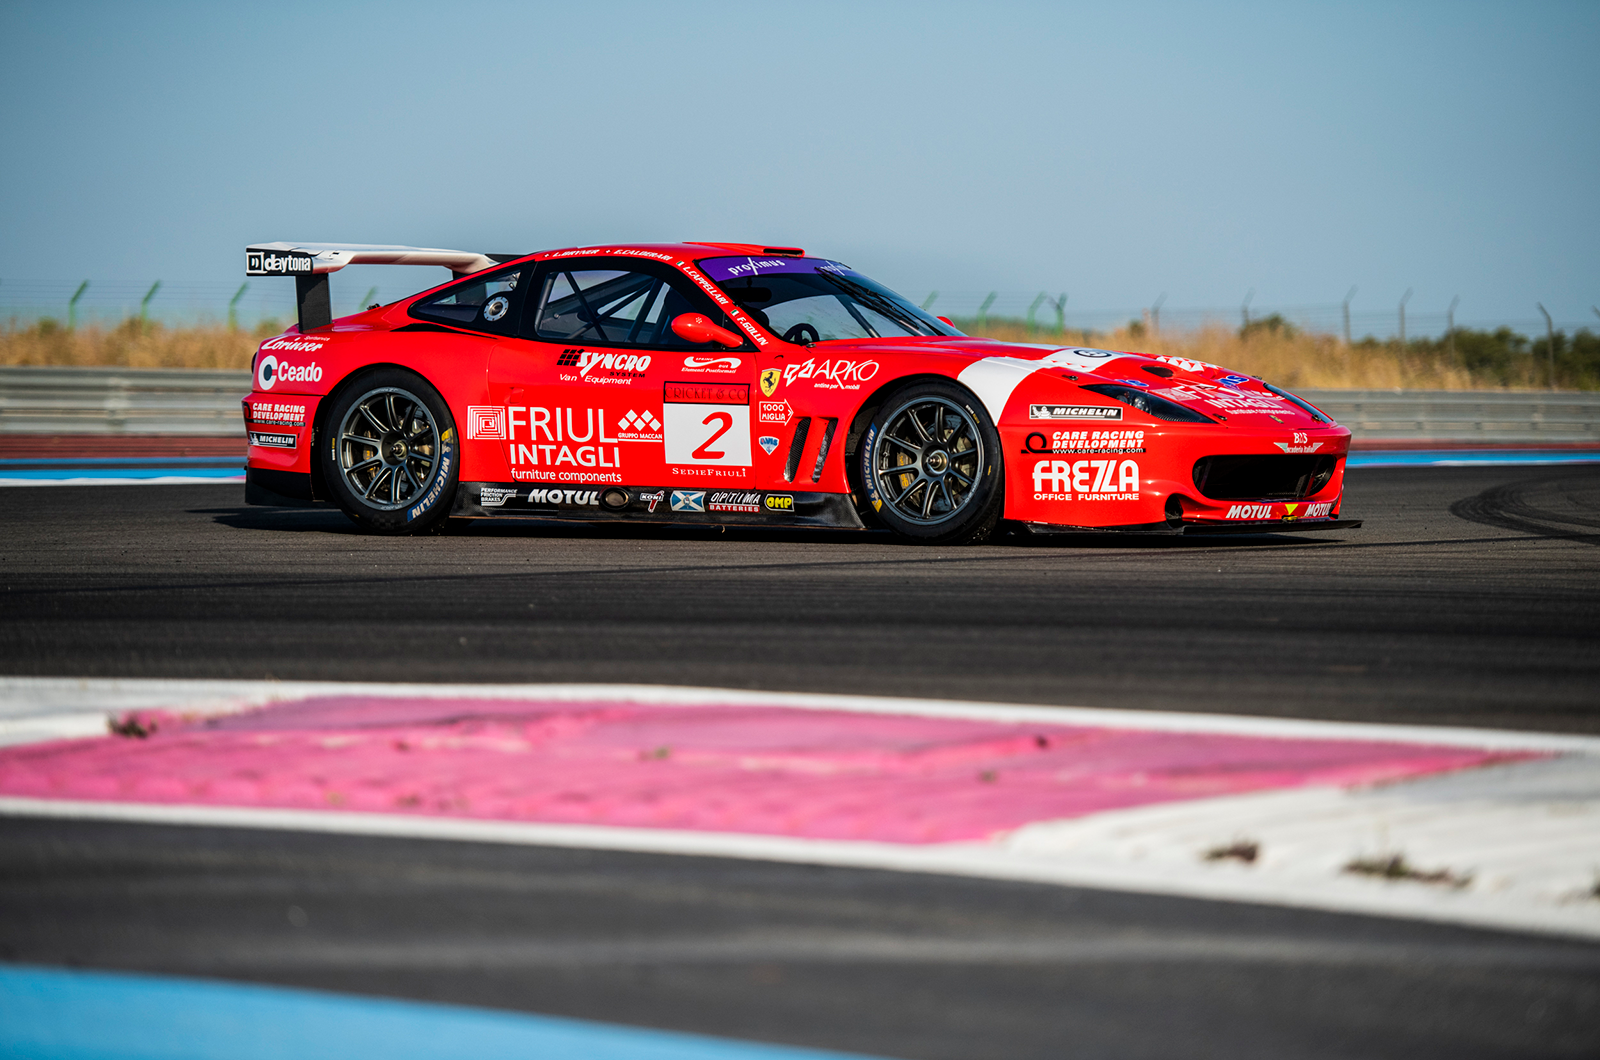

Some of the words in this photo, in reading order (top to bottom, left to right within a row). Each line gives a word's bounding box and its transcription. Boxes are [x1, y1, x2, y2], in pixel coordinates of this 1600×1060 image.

[264, 254, 311, 273] daytona
[728, 257, 785, 275] proximus
[682, 266, 729, 305] L.CAPPELLARI
[736, 317, 769, 346] F.GOLLIN
[278, 361, 322, 382] Ceado
[576, 352, 651, 377] SYNCRO
[560, 373, 578, 382] Van
[584, 375, 632, 385] Equipment
[812, 359, 880, 389] ARKO
[665, 386, 712, 399] CRICKET
[716, 389, 724, 399] &
[728, 388, 746, 400] CO
[253, 403, 273, 411] CARE
[274, 404, 305, 413] RACING
[253, 411, 305, 421] DEVELOPMENT
[1052, 407, 1118, 416] MICHELIN
[508, 406, 618, 443] FRIUL
[259, 435, 295, 444] MICHELIN
[639, 432, 662, 440] MACCAN
[691, 411, 733, 459] 2
[1052, 431, 1088, 440] CARE
[1091, 430, 1145, 439] RACING
[1052, 440, 1144, 449] DEVELOPMENT
[510, 444, 620, 467] INTAGLI
[863, 429, 877, 489] MICHELIN
[511, 468, 556, 480] furniture
[558, 471, 622, 483] components
[1032, 459, 1139, 492] FREZZA
[411, 457, 450, 518] MICHELIN
[528, 488, 599, 505] MOTUL
[766, 496, 793, 508] OMP
[709, 504, 760, 512] BATTERIES
[1225, 504, 1272, 519] MOTUL
[1304, 503, 1333, 517] MOTUL
